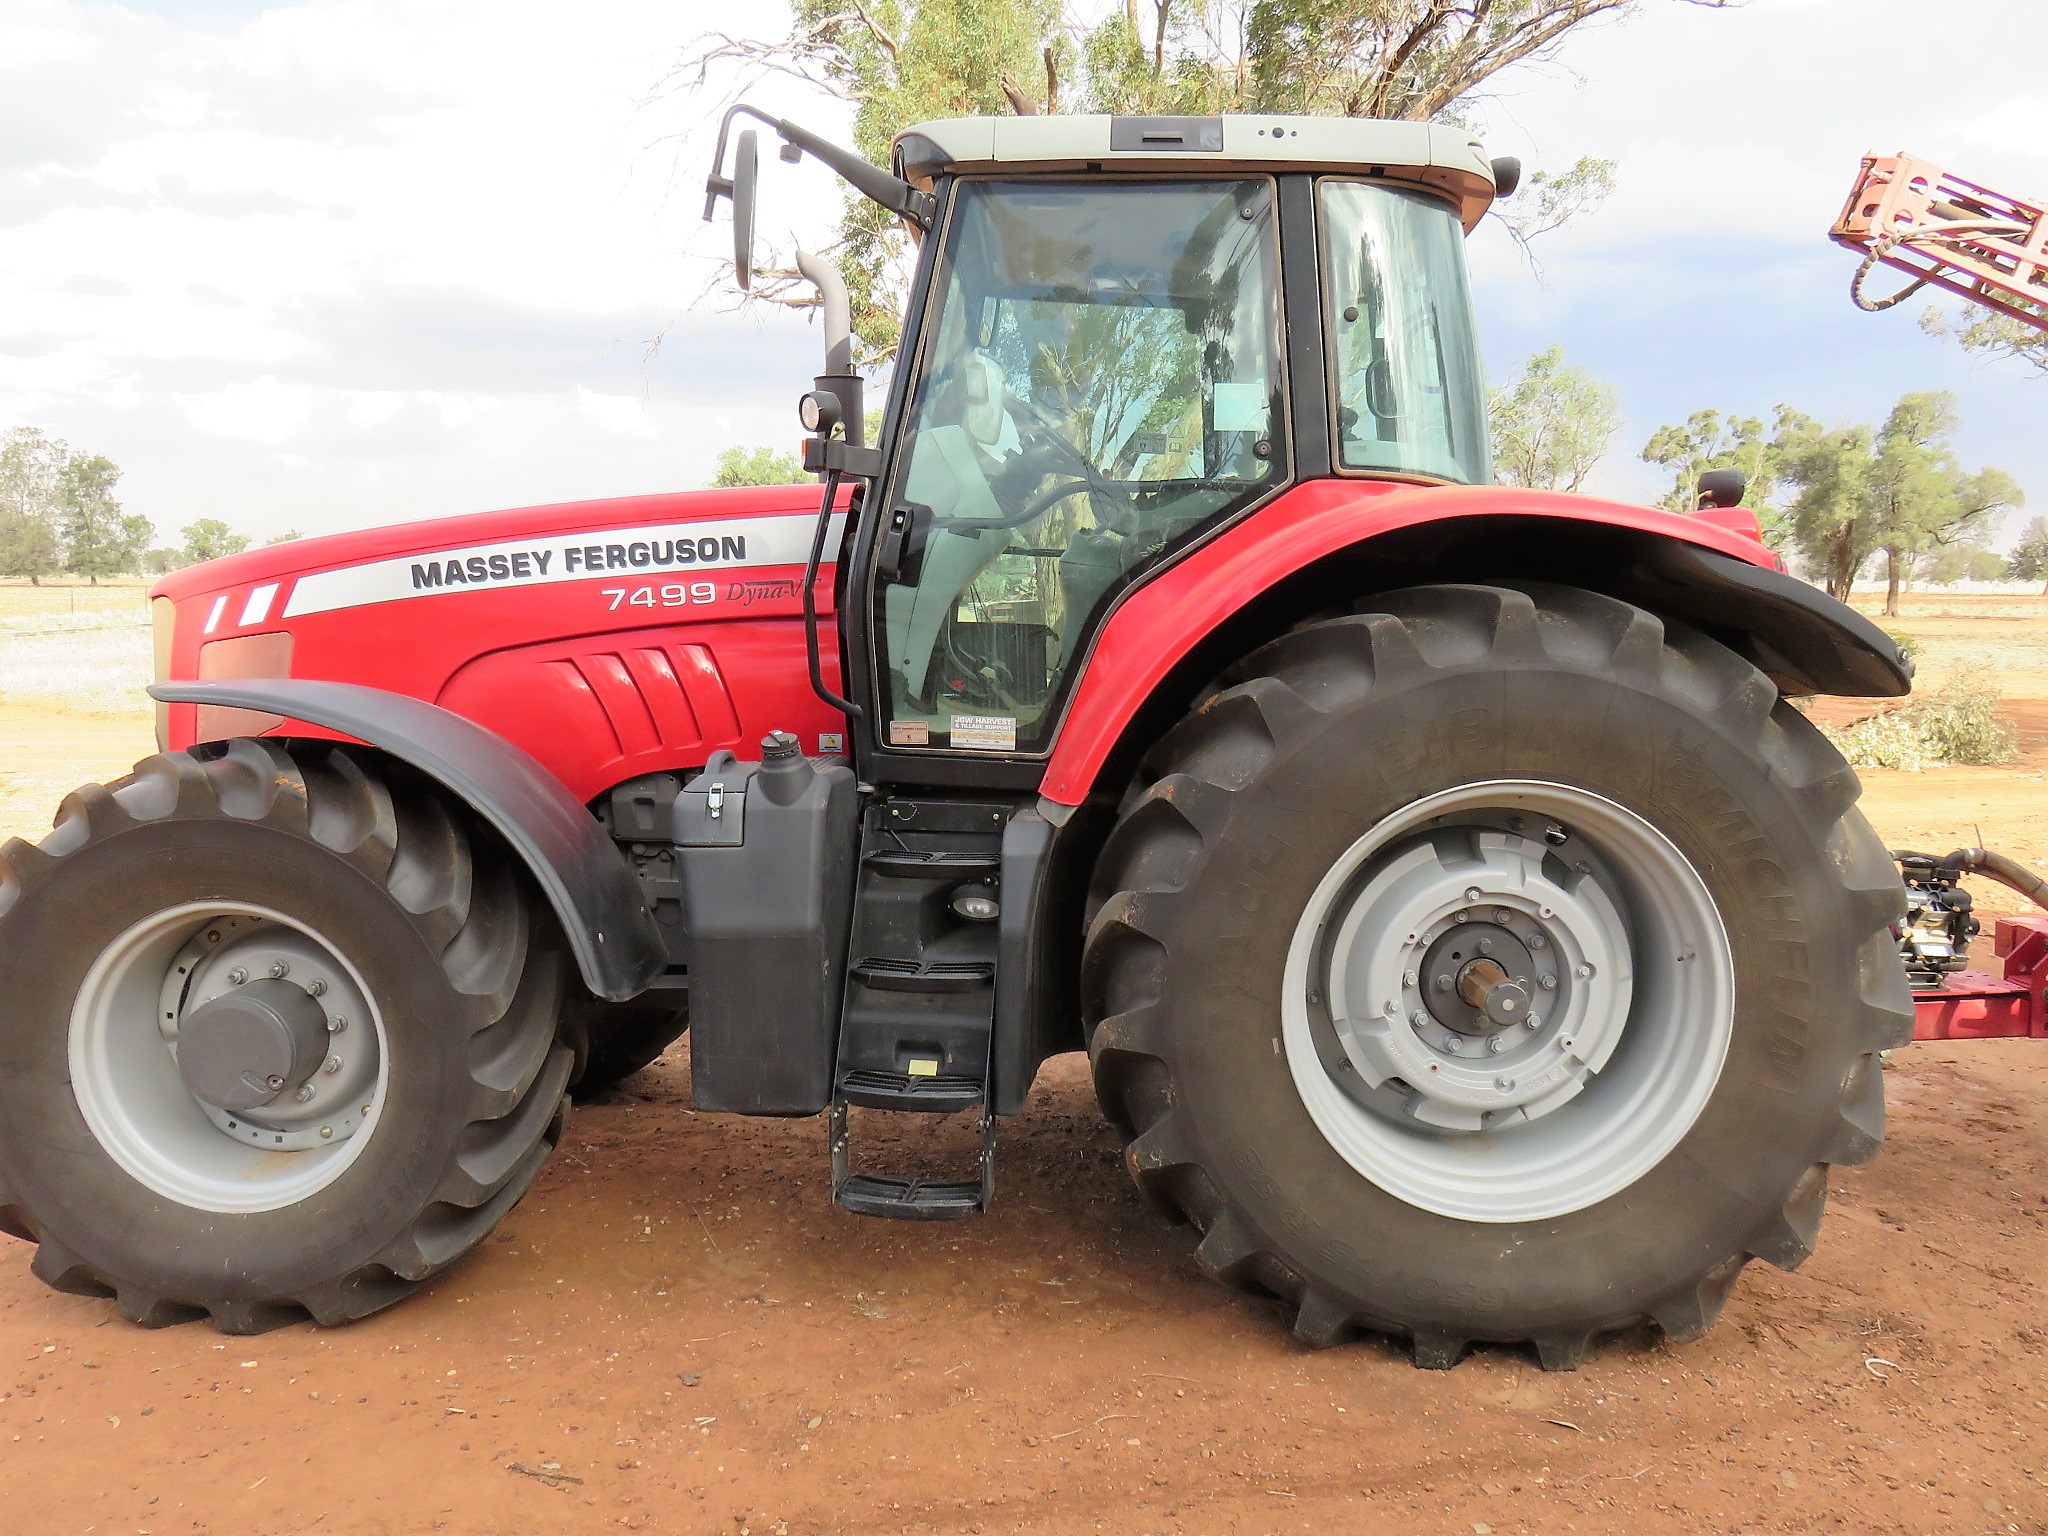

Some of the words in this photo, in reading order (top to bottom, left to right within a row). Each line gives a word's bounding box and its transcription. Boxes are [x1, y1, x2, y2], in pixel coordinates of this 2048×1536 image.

[411, 549, 552, 590] MASSEY
[564, 535, 747, 573] FERGUSON
[601, 582, 717, 611] 7499
[974, 717, 1012, 726] HARVEST
[984, 724, 1012, 732] SUPPORT
